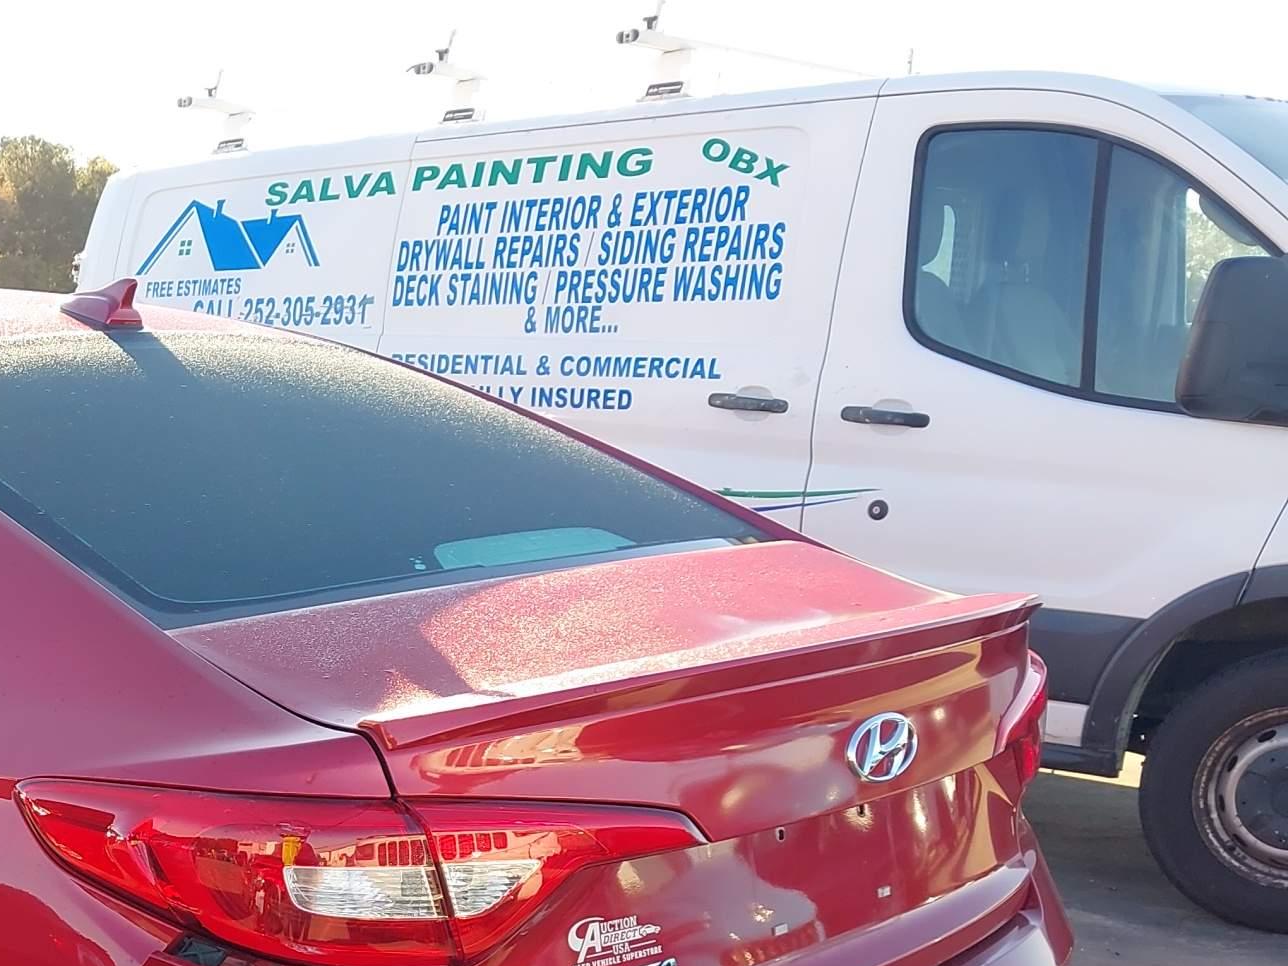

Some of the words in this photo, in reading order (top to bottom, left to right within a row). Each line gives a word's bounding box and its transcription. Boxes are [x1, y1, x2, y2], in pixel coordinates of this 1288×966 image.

[702, 138, 790, 187] OBX
[265, 171, 396, 206] SALVA
[412, 148, 654, 192] PAINTING
[436, 202, 497, 235] PAINT
[500, 195, 601, 232] INTERIOR
[608, 193, 623, 227] &
[630, 185, 750, 226] EXTERIOR
[397, 236, 486, 272] DRYWALL
[493, 233, 581, 269] REPAIRS
[597, 228, 675, 266] SIDING
[681, 222, 786, 263] REPAIRS
[146, 280, 173, 298] FREE
[177, 278, 241, 296] ESTIMATES
[392, 274, 442, 307] DECK
[446, 271, 538, 306] STAINING
[554, 266, 667, 304] PRESSURE
[673, 262, 783, 302] WASHING
[524, 307, 536, 334] &
[544, 306, 618, 334] MORE...
[536, 355, 551, 376] &
[560, 355, 721, 379] COMMERCIAL
[531, 387, 632, 410] INSURED
[602, 928, 638, 945] DIRECT
[613, 943, 630, 955] USA
[622, 945, 663, 962] SUPERSTORE
